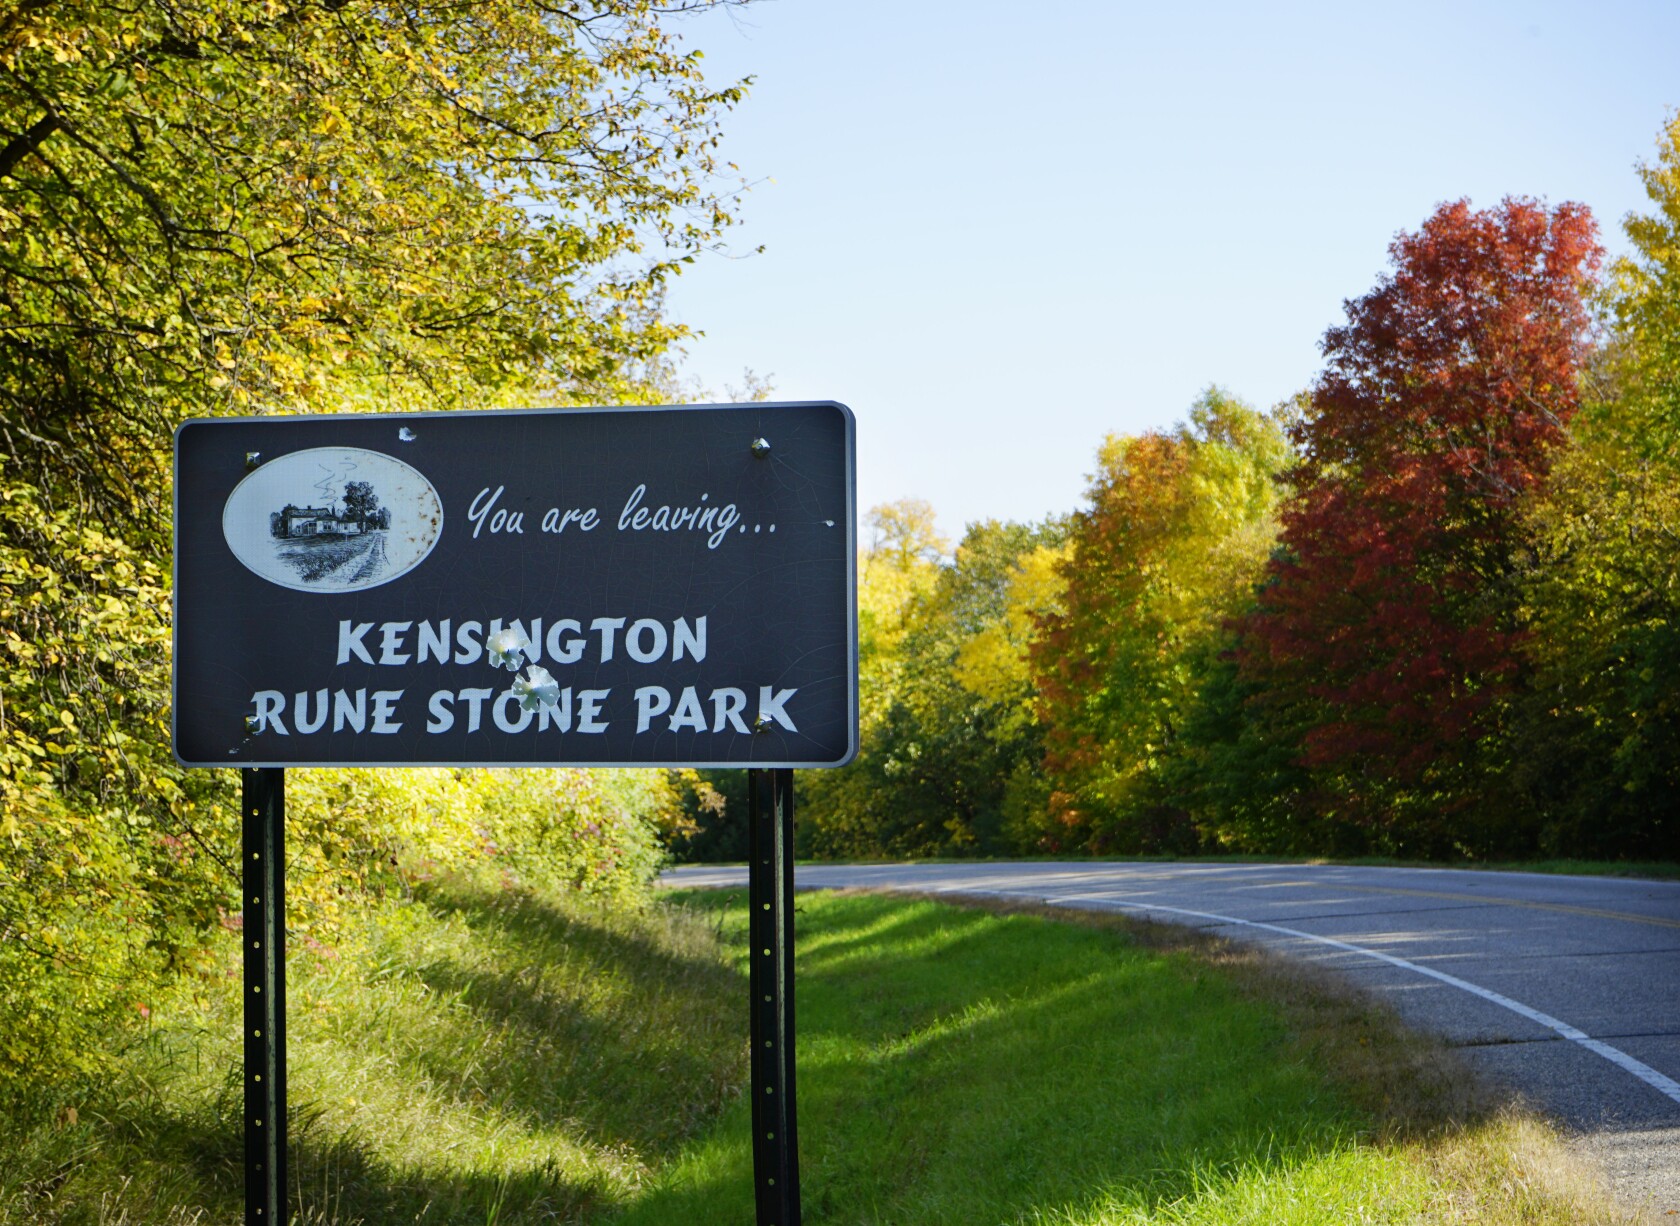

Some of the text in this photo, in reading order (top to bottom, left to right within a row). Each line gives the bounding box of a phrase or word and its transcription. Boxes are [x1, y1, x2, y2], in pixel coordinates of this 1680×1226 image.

[468, 484, 776, 550] You are leaving...
[249, 685, 799, 736] RUNE STONE PARK
